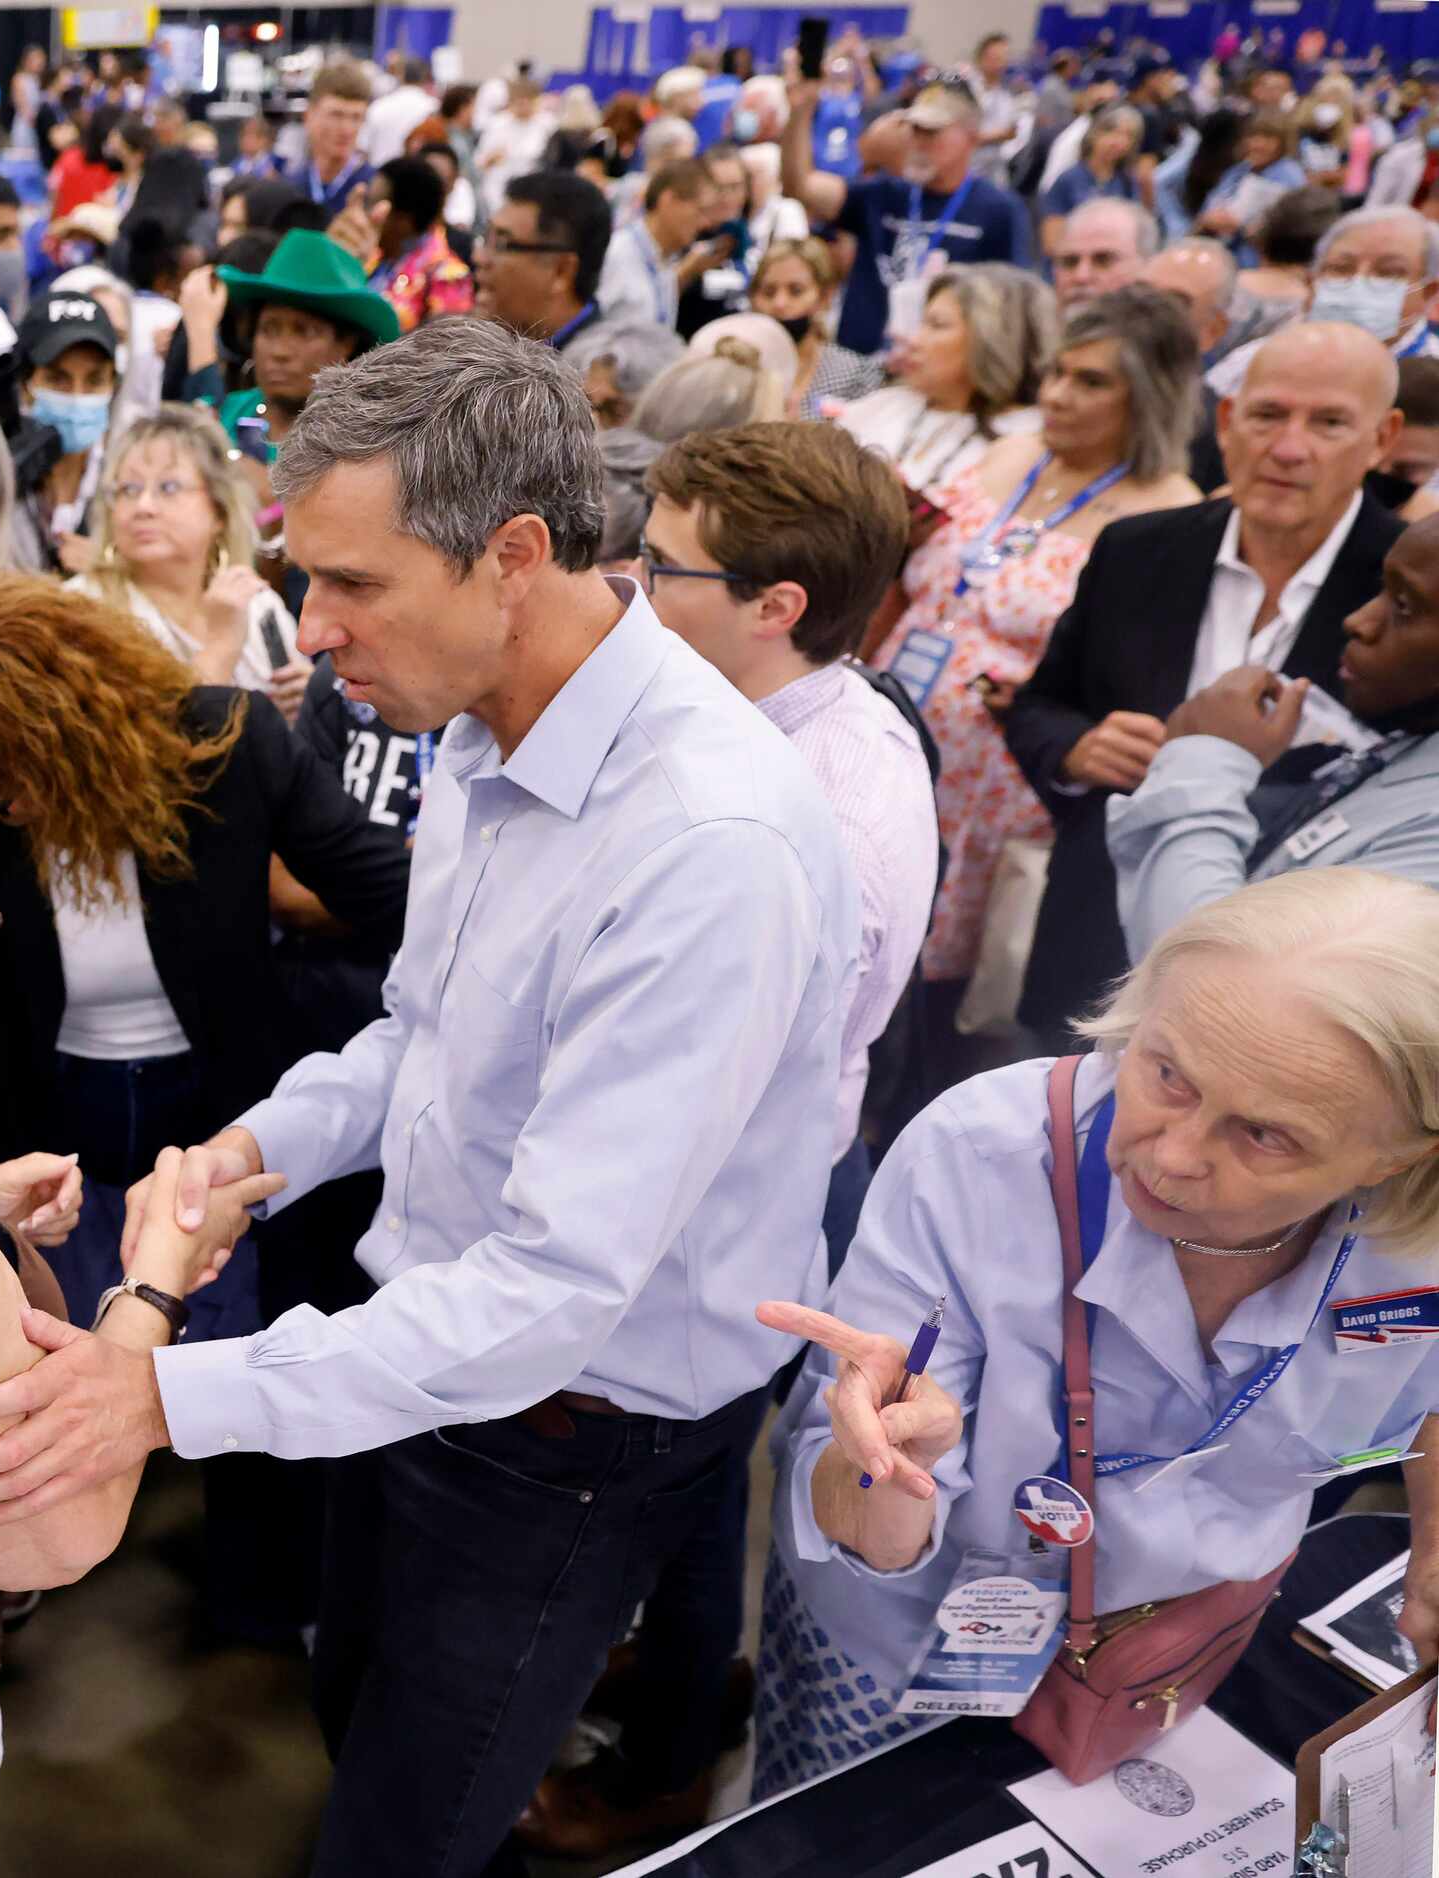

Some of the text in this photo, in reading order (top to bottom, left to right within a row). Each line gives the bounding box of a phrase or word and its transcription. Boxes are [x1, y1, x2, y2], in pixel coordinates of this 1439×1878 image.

[1342, 1306, 1421, 1328] DAVID GRIGGS
[1254, 1351, 1291, 1398] TEXAS
[1096, 1453, 1148, 1473] WOME
[1038, 1511, 1076, 1521] VOTER
[913, 1701, 1006, 1712] DELEGATE
[1250, 1798, 1285, 1821] SCAN
[1202, 1826, 1224, 1843] TO
[1219, 1814, 1252, 1836] HERE
[1253, 1850, 1290, 1872] YARD
